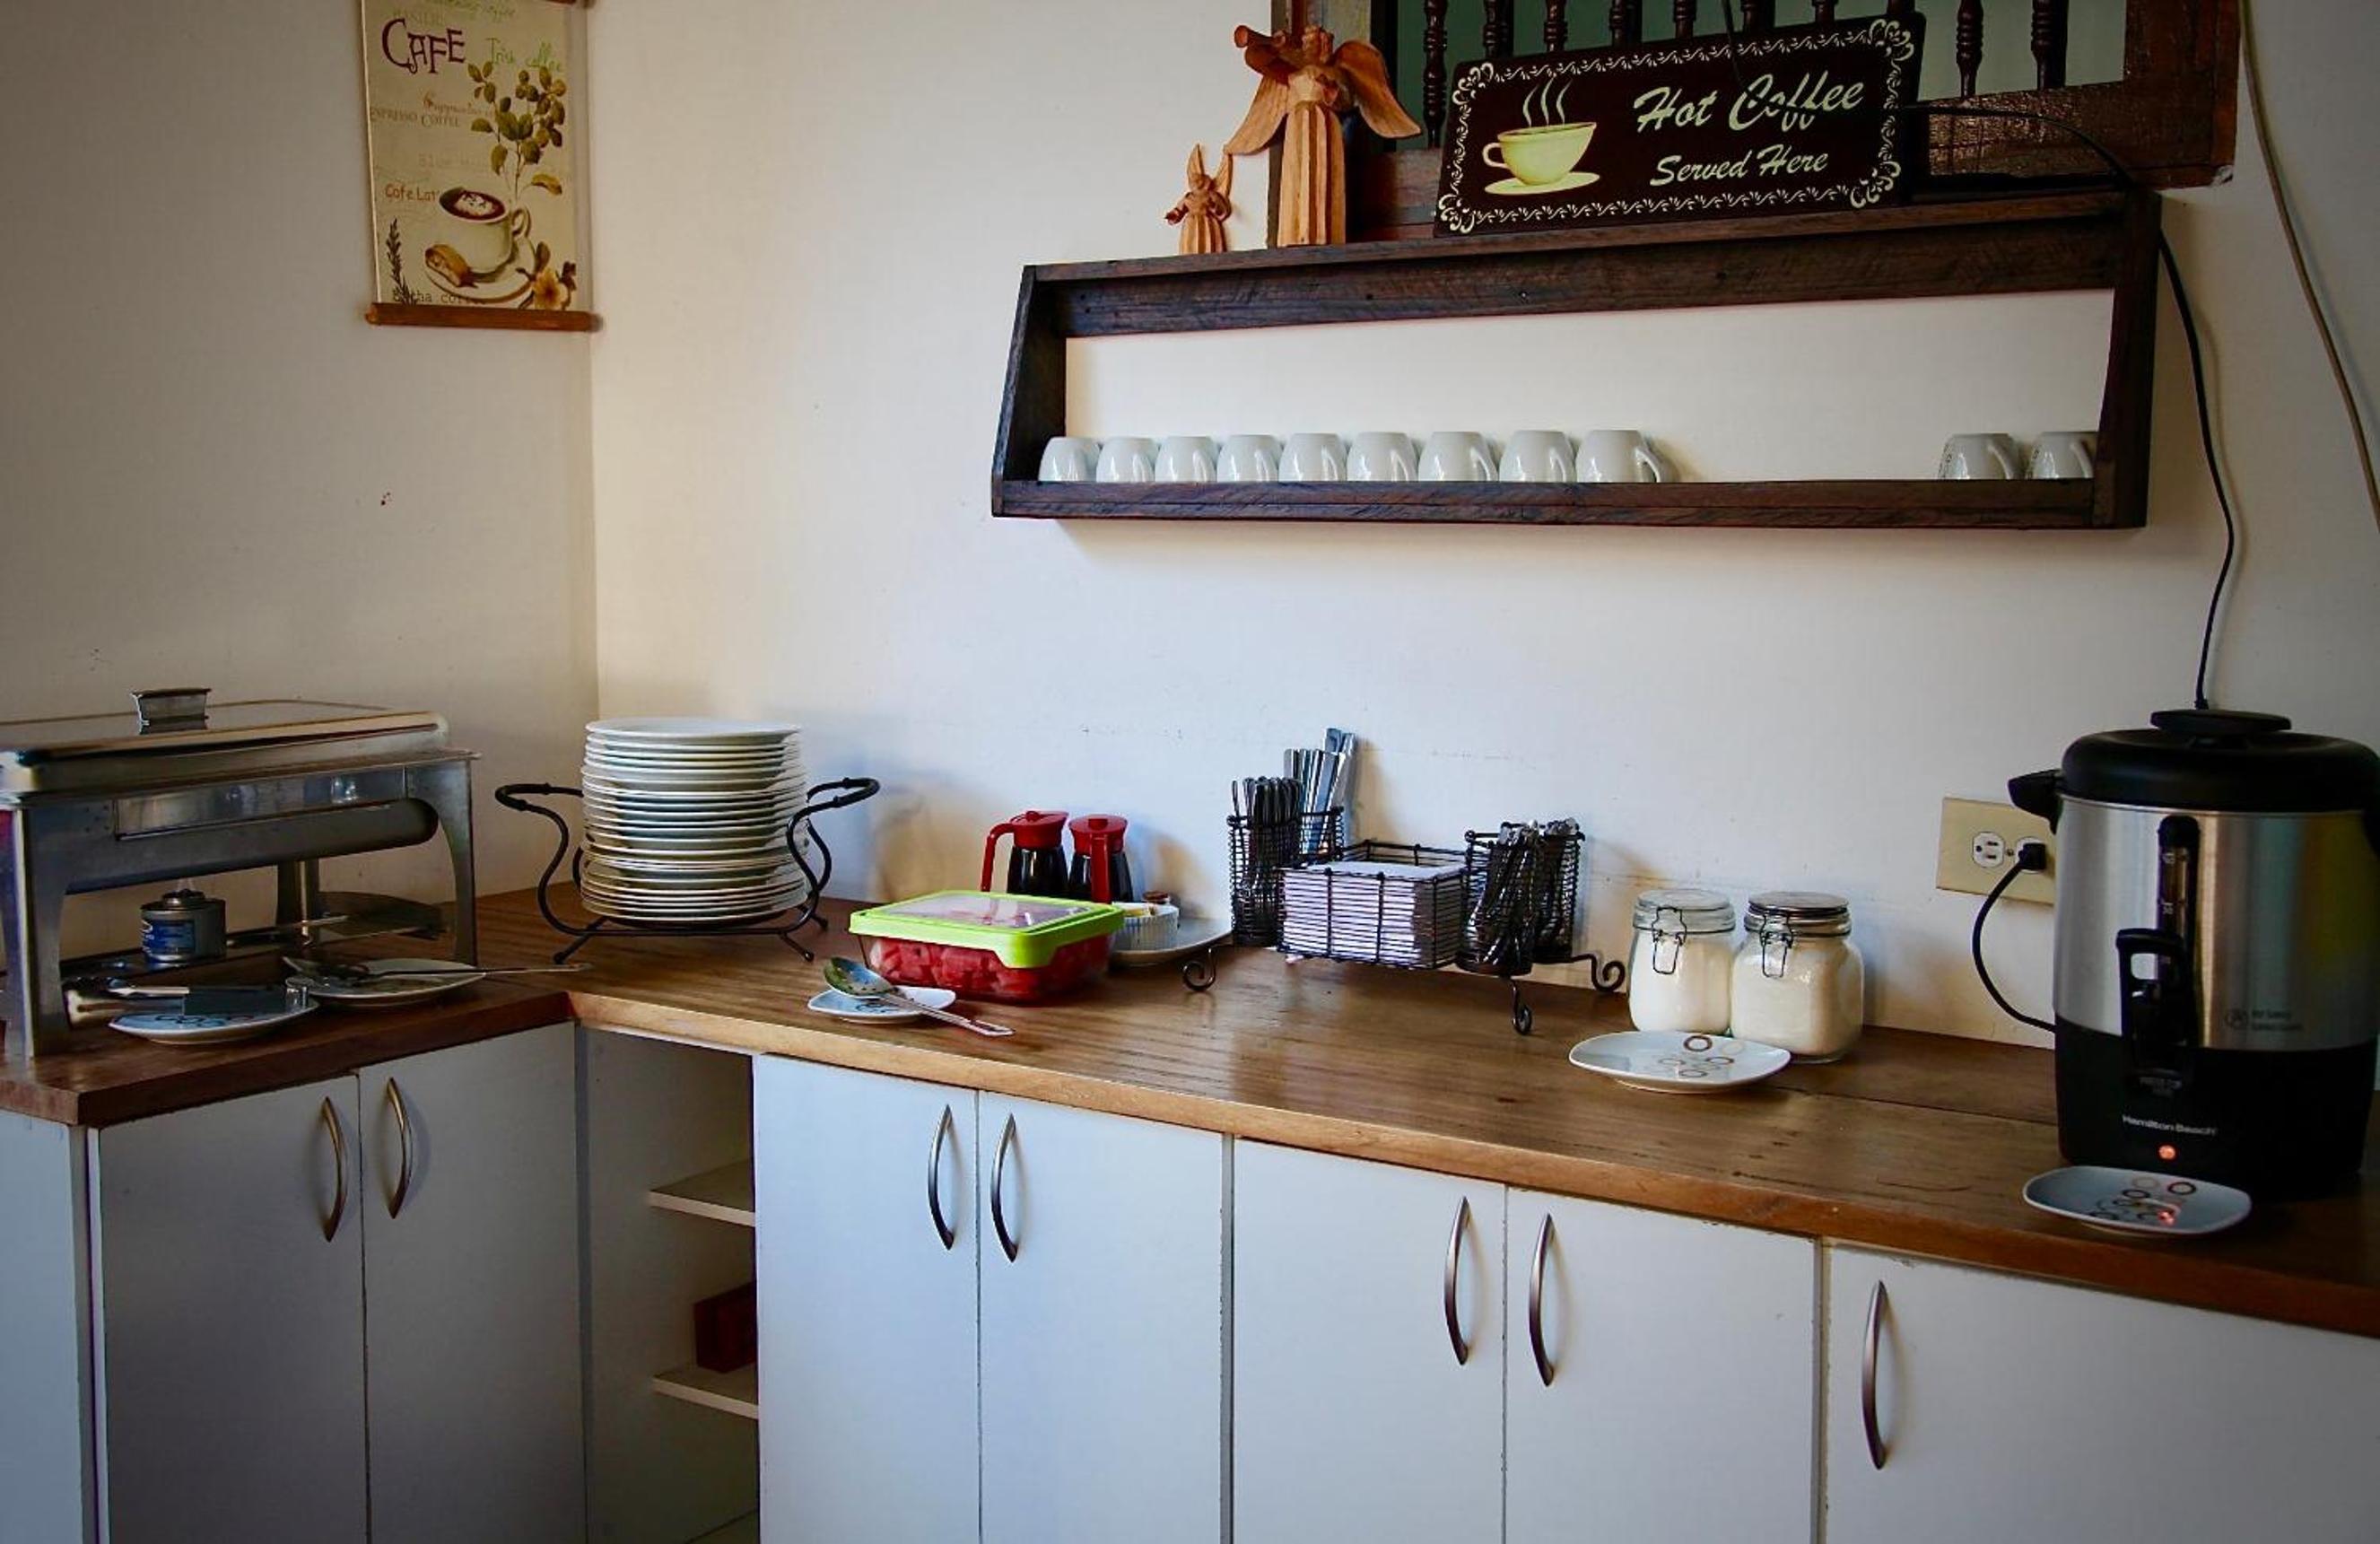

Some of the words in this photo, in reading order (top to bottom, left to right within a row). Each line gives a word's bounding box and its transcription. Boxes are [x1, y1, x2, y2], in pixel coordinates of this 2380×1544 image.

[381, 18, 466, 74] CAFE
[1633, 87, 1719, 134] Hot
[1728, 70, 1864, 132] Coffee
[1649, 150, 1753, 187] Served
[1757, 144, 1828, 177] Here
